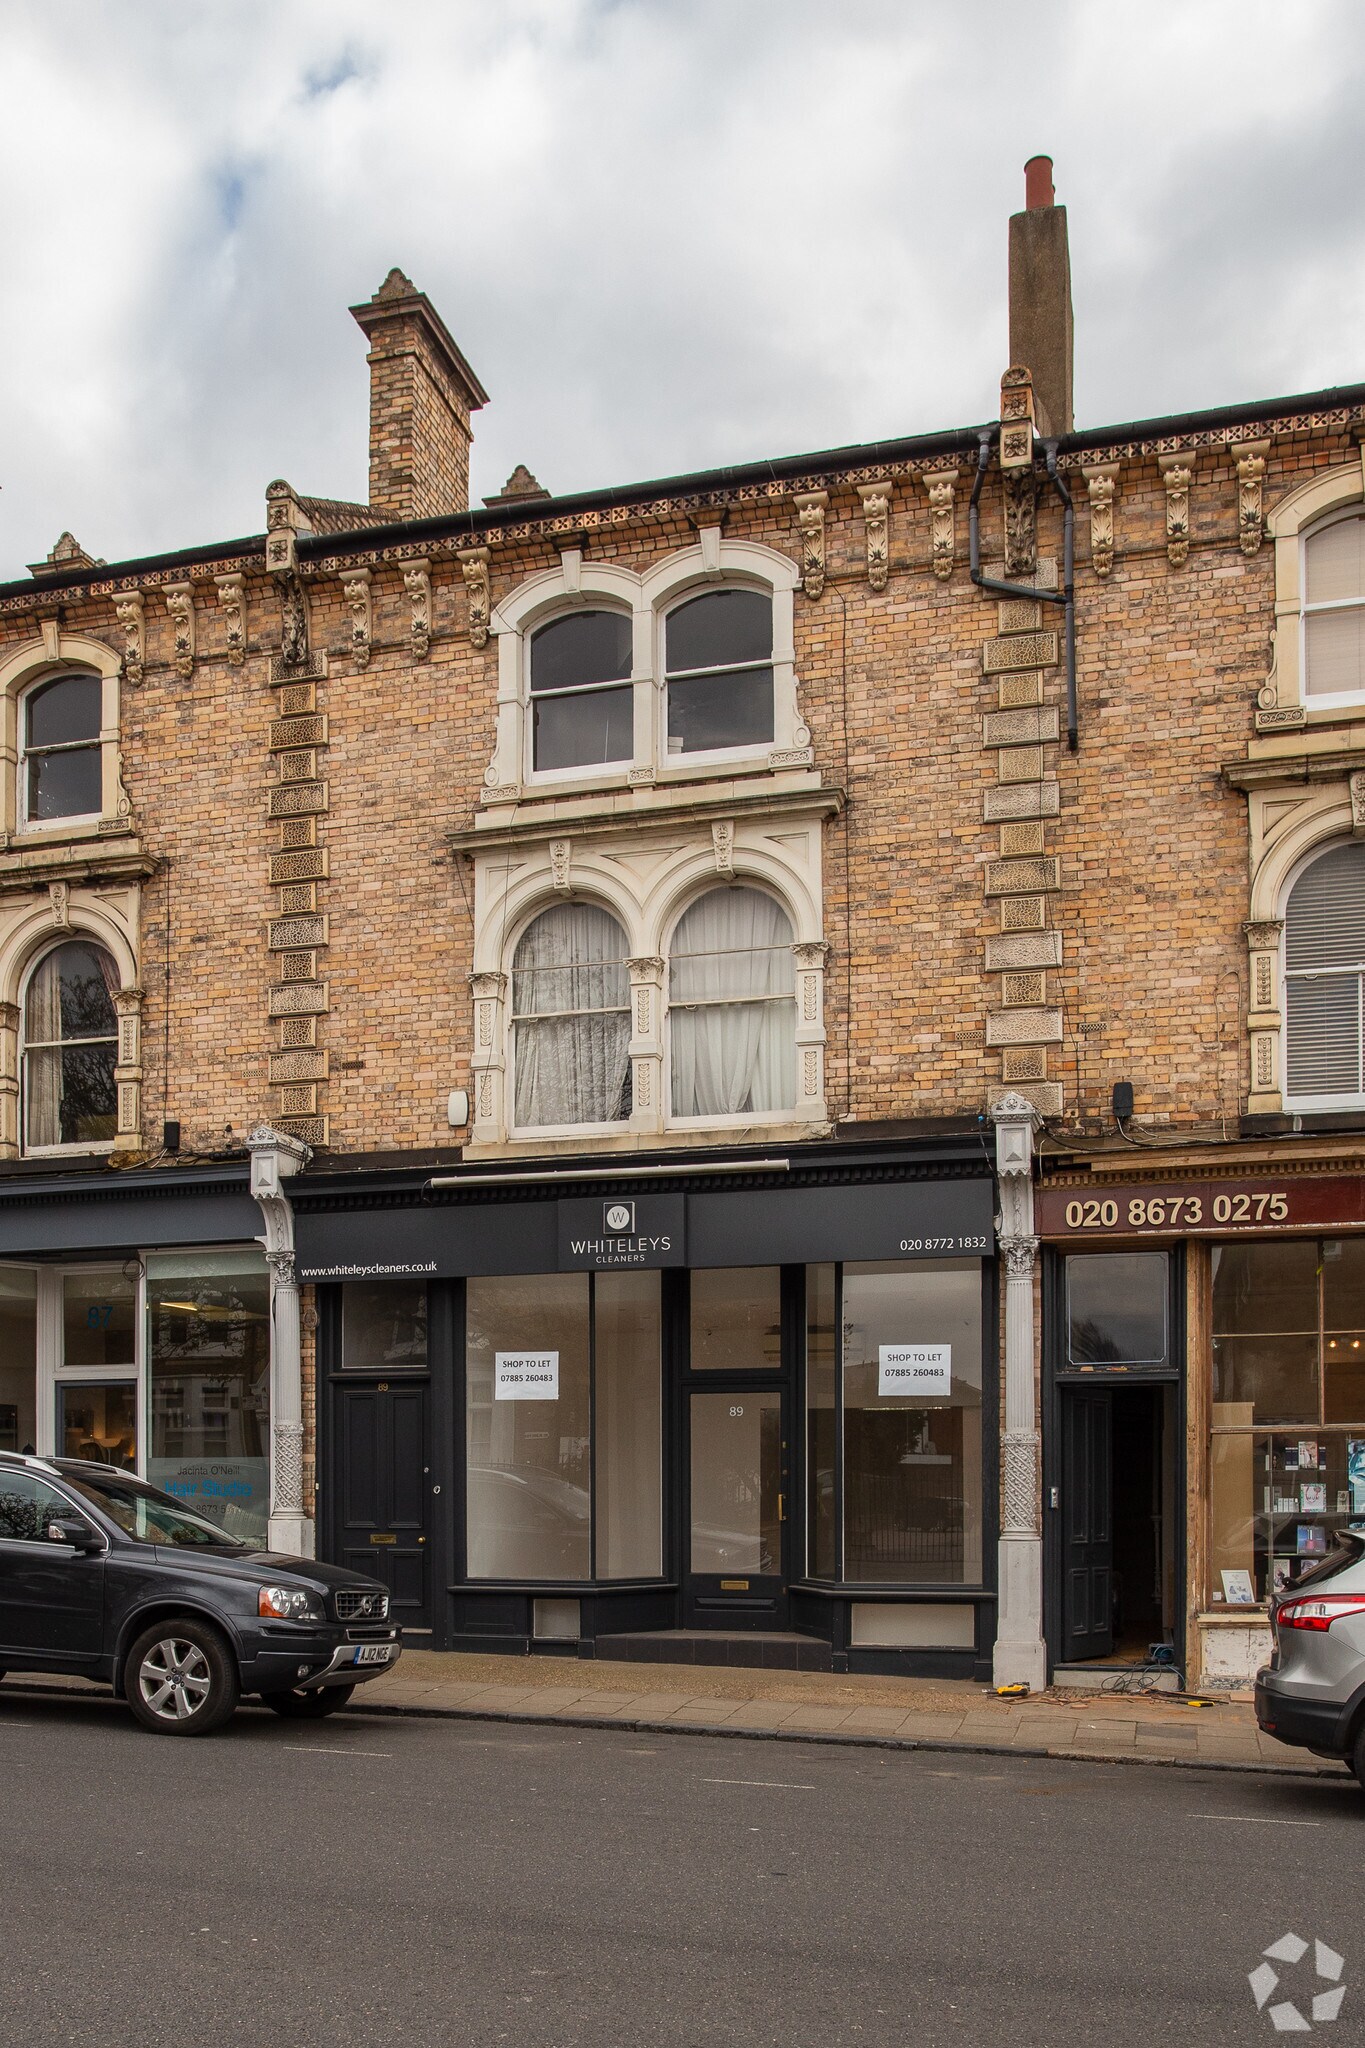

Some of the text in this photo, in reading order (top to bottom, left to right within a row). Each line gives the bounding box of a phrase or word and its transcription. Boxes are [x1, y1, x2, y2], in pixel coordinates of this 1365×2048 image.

[1065, 1192, 1289, 1228] 020 8673 0275
[611, 1212, 625, 1223] W
[570, 1236, 671, 1255] WHITELEYS
[900, 1236, 987, 1251] 020 8772 1832
[596, 1254, 645, 1264] CLEANERS
[301, 1261, 438, 1277] www.whiteleyscleaners.co.uk
[87, 1306, 113, 1329] 87
[887, 1353, 942, 1362] SHOP TO LET
[502, 1360, 551, 1368] SHOP TO LET
[500, 1374, 553, 1382] 07885 260483
[884, 1369, 945, 1377] 07885 260483
[377, 1383, 389, 1392] 89
[729, 1406, 744, 1417] 89
[177, 1466, 208, 1476] Jacinta
[165, 1480, 252, 1497] Hair Studio
